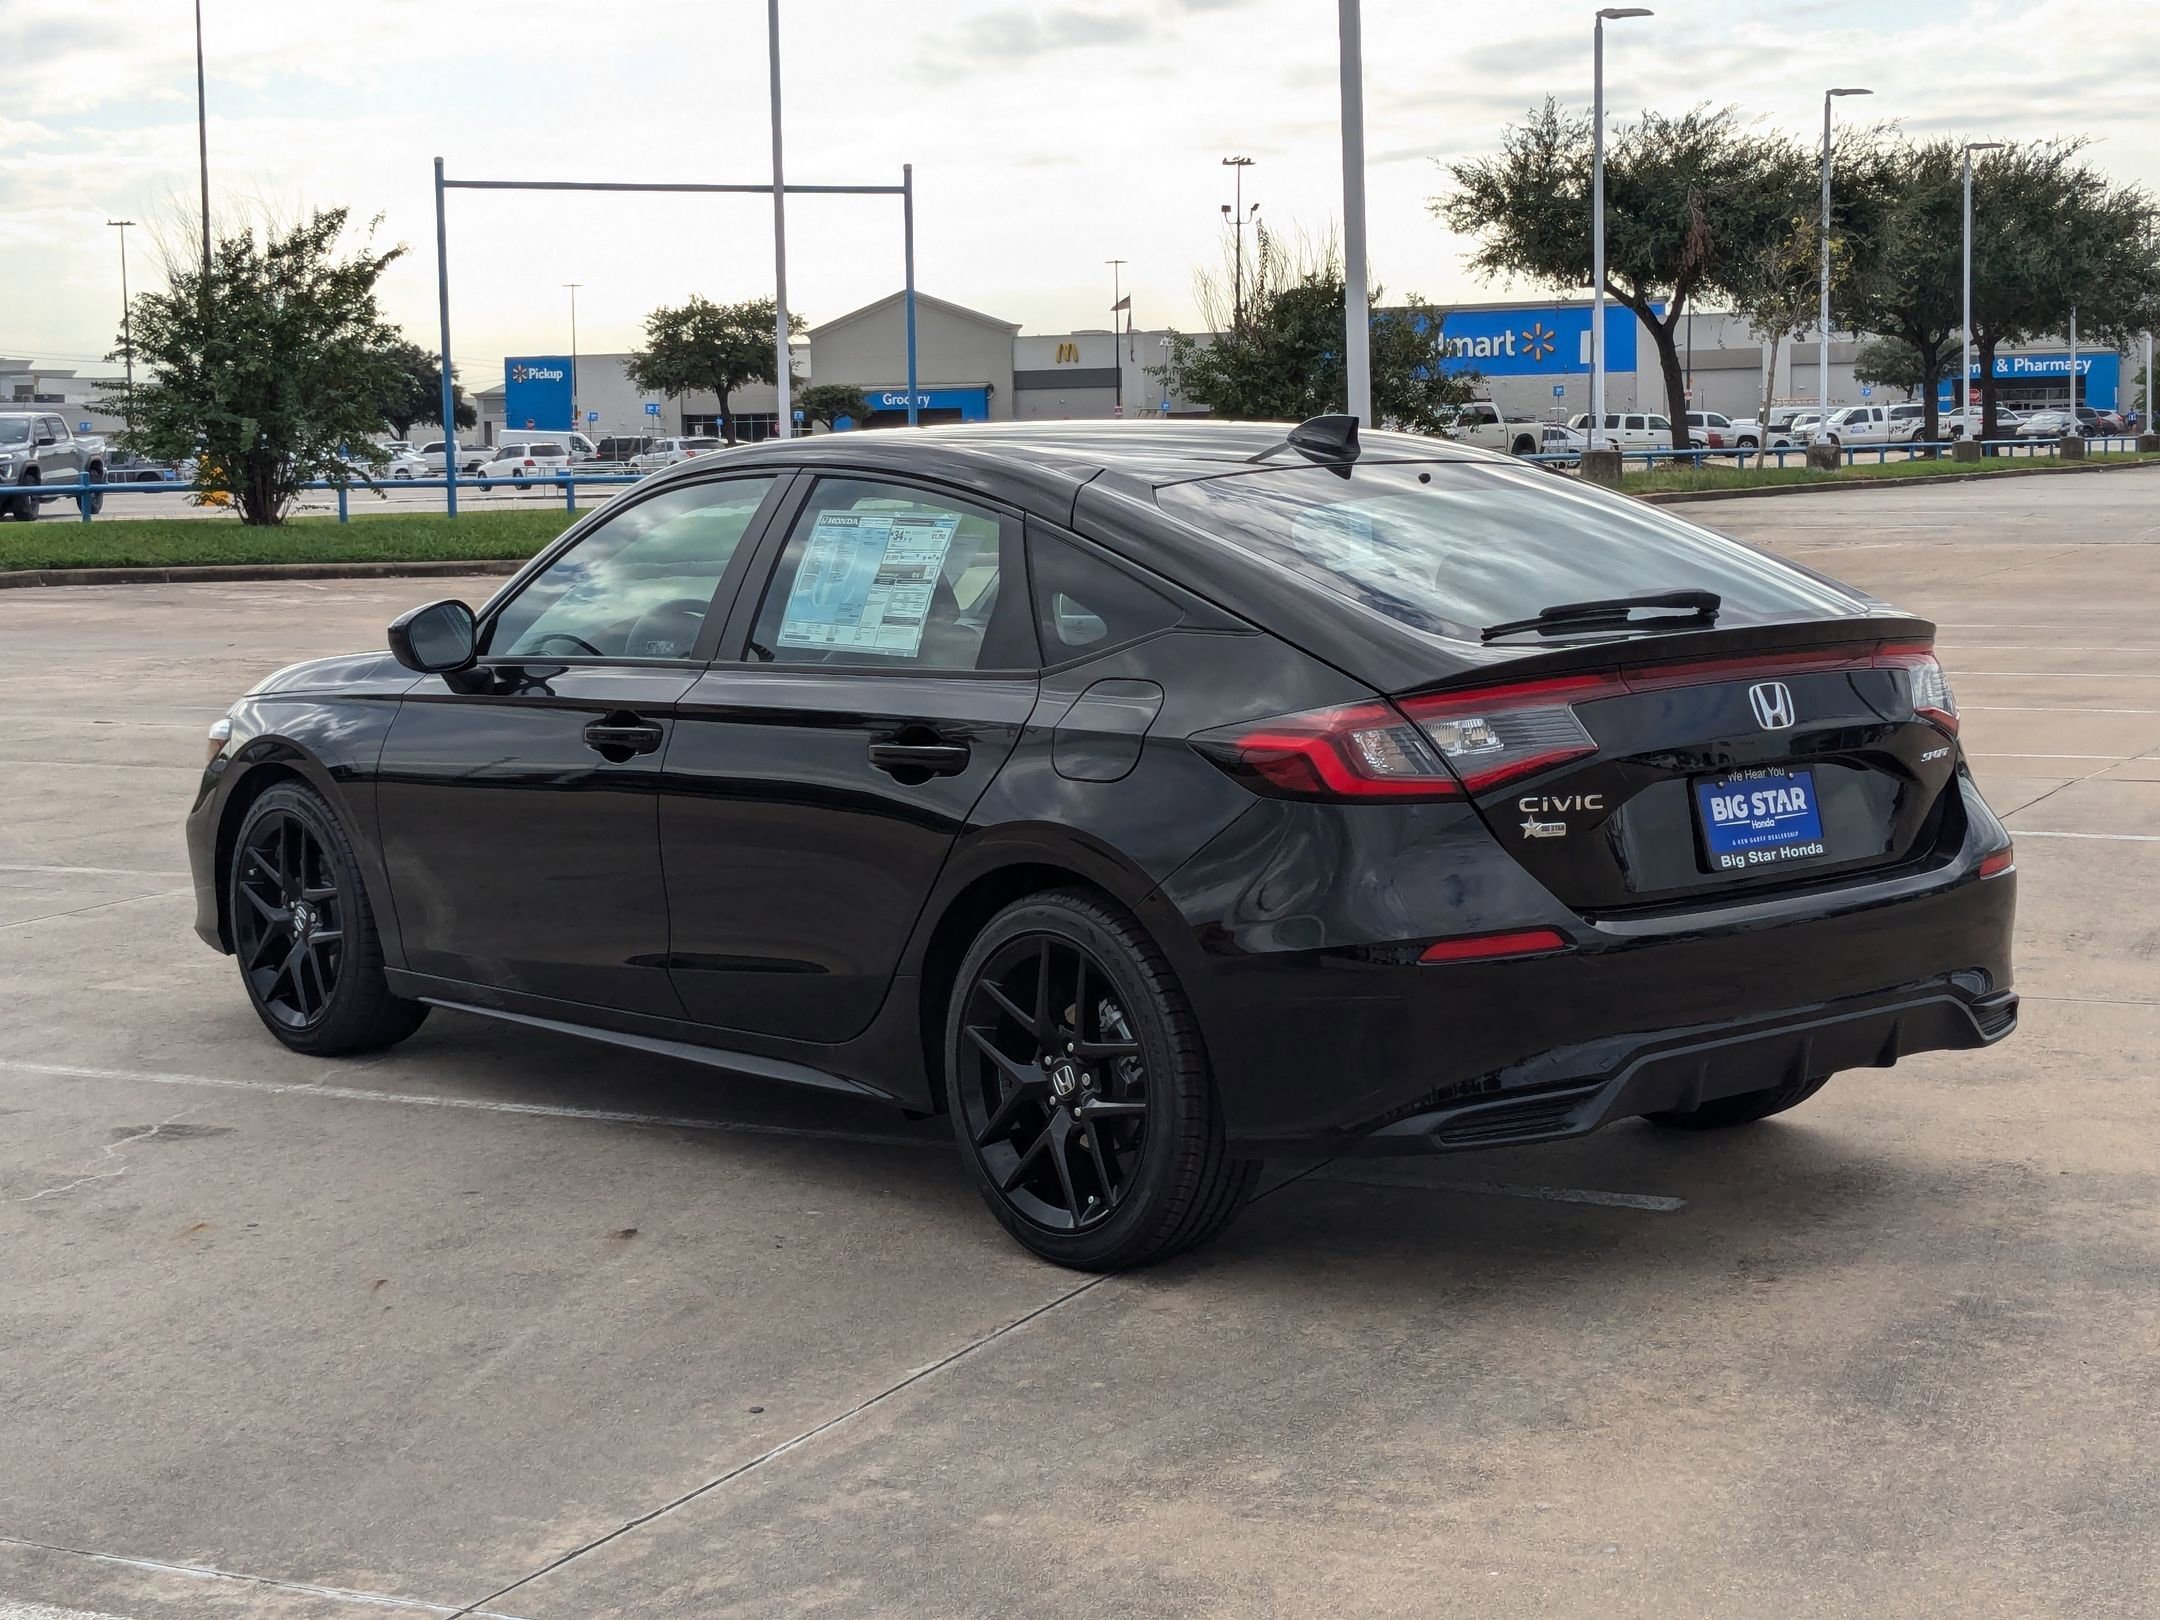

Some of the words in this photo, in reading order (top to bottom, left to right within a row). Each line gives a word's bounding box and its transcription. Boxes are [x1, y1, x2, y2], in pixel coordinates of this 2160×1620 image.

[1996, 358, 2009, 373] &
[2014, 358, 2092, 374] Pharmacy
[528, 367, 564, 382] Pickup
[882, 393, 931, 408] Grocry
[827, 516, 859, 526] HONDA
[893, 529, 905, 541] 34
[1727, 771, 1743, 782] We
[1744, 769, 1767, 781] Hear
[1767, 766, 1786, 778] You
[1518, 794, 1604, 813] CIVIC
[1710, 794, 1748, 821] BIG
[1751, 787, 1808, 816] STAR
[1751, 817, 1775, 829] Honda
[1720, 854, 1745, 868] Big
[1748, 850, 1777, 864] Star
[1780, 843, 1824, 859] Honda
